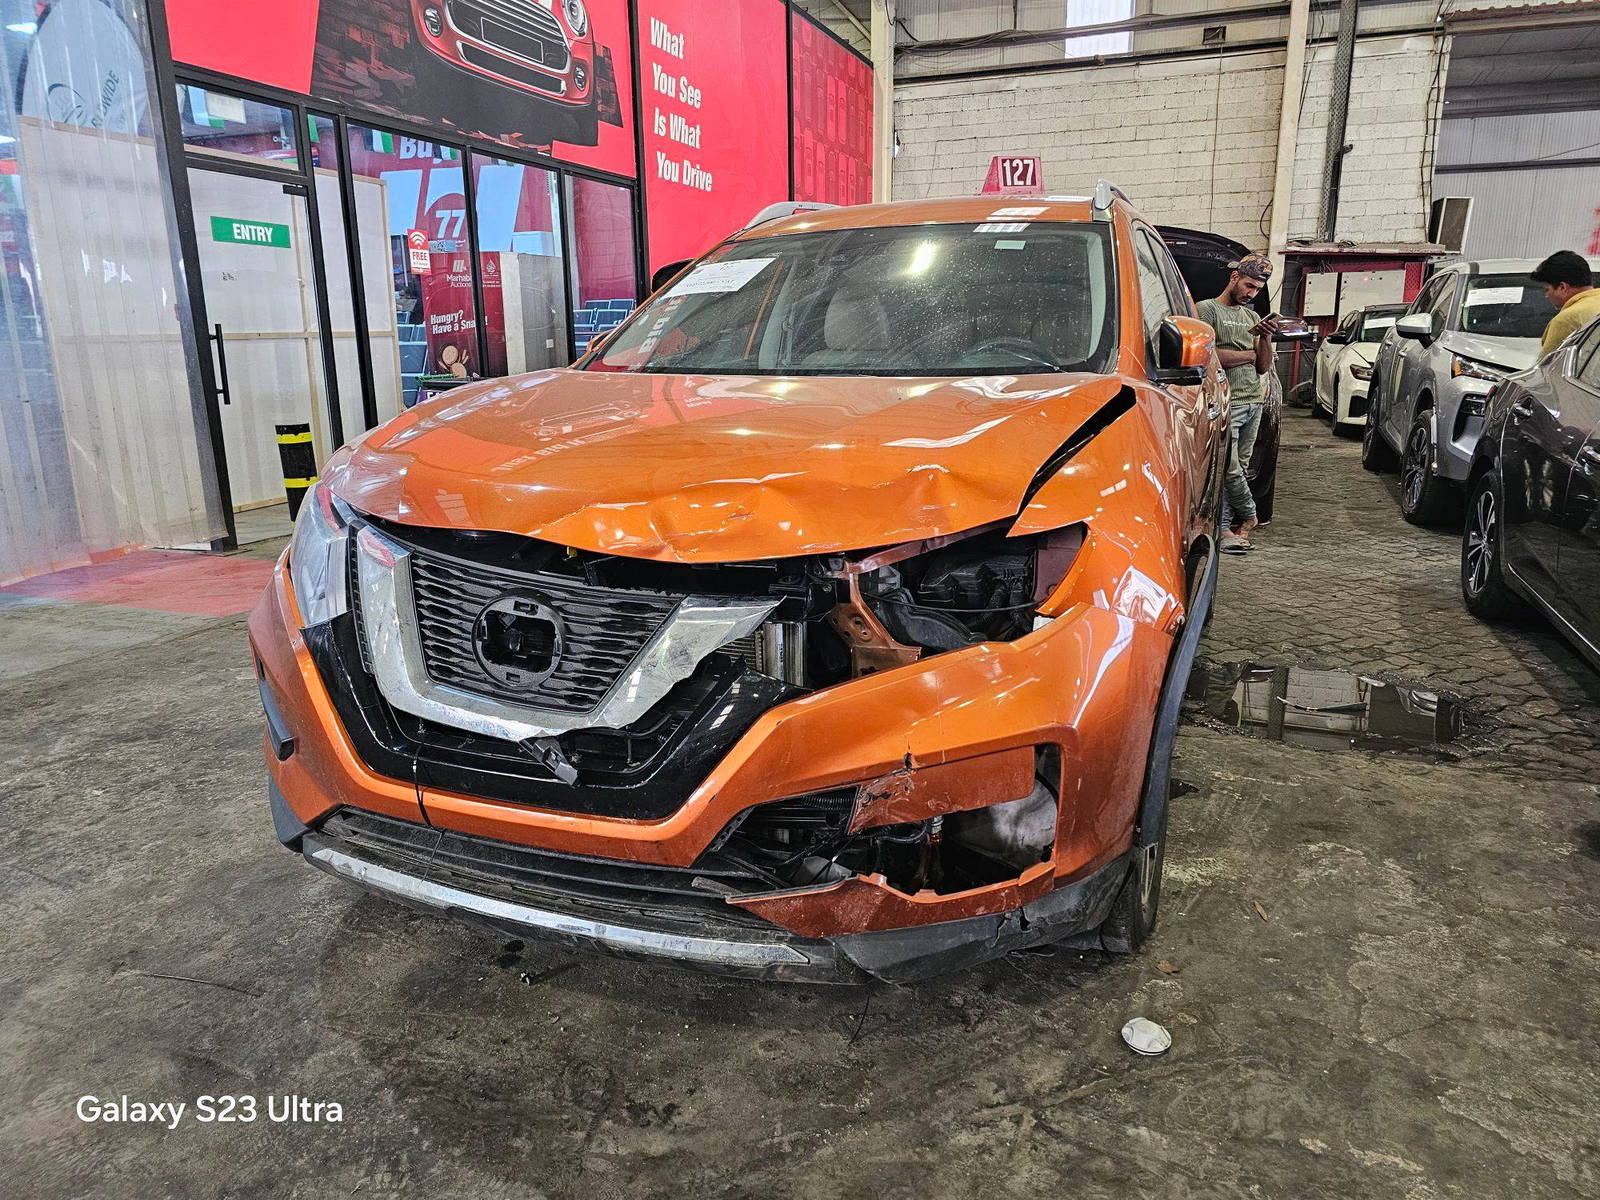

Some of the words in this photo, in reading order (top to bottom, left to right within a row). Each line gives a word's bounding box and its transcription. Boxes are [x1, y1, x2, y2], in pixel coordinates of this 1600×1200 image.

[650, 16, 684, 60] What
[652, 62, 677, 98] You
[679, 75, 702, 109] See
[654, 107, 666, 137] Is
[669, 112, 701, 150] What
[400, 136, 443, 165] Bu
[656, 150, 680, 183] You
[682, 159, 712, 192] Drive
[1003, 158, 1034, 187] 127
[232, 223, 273, 243] ENTRY
[435, 209, 466, 239] 77
[412, 251, 428, 261] FREE
[446, 273, 472, 282] Marhab
[430, 309, 464, 325] Hungry?
[432, 323, 453, 335] Have
[453, 321, 460, 332] a
